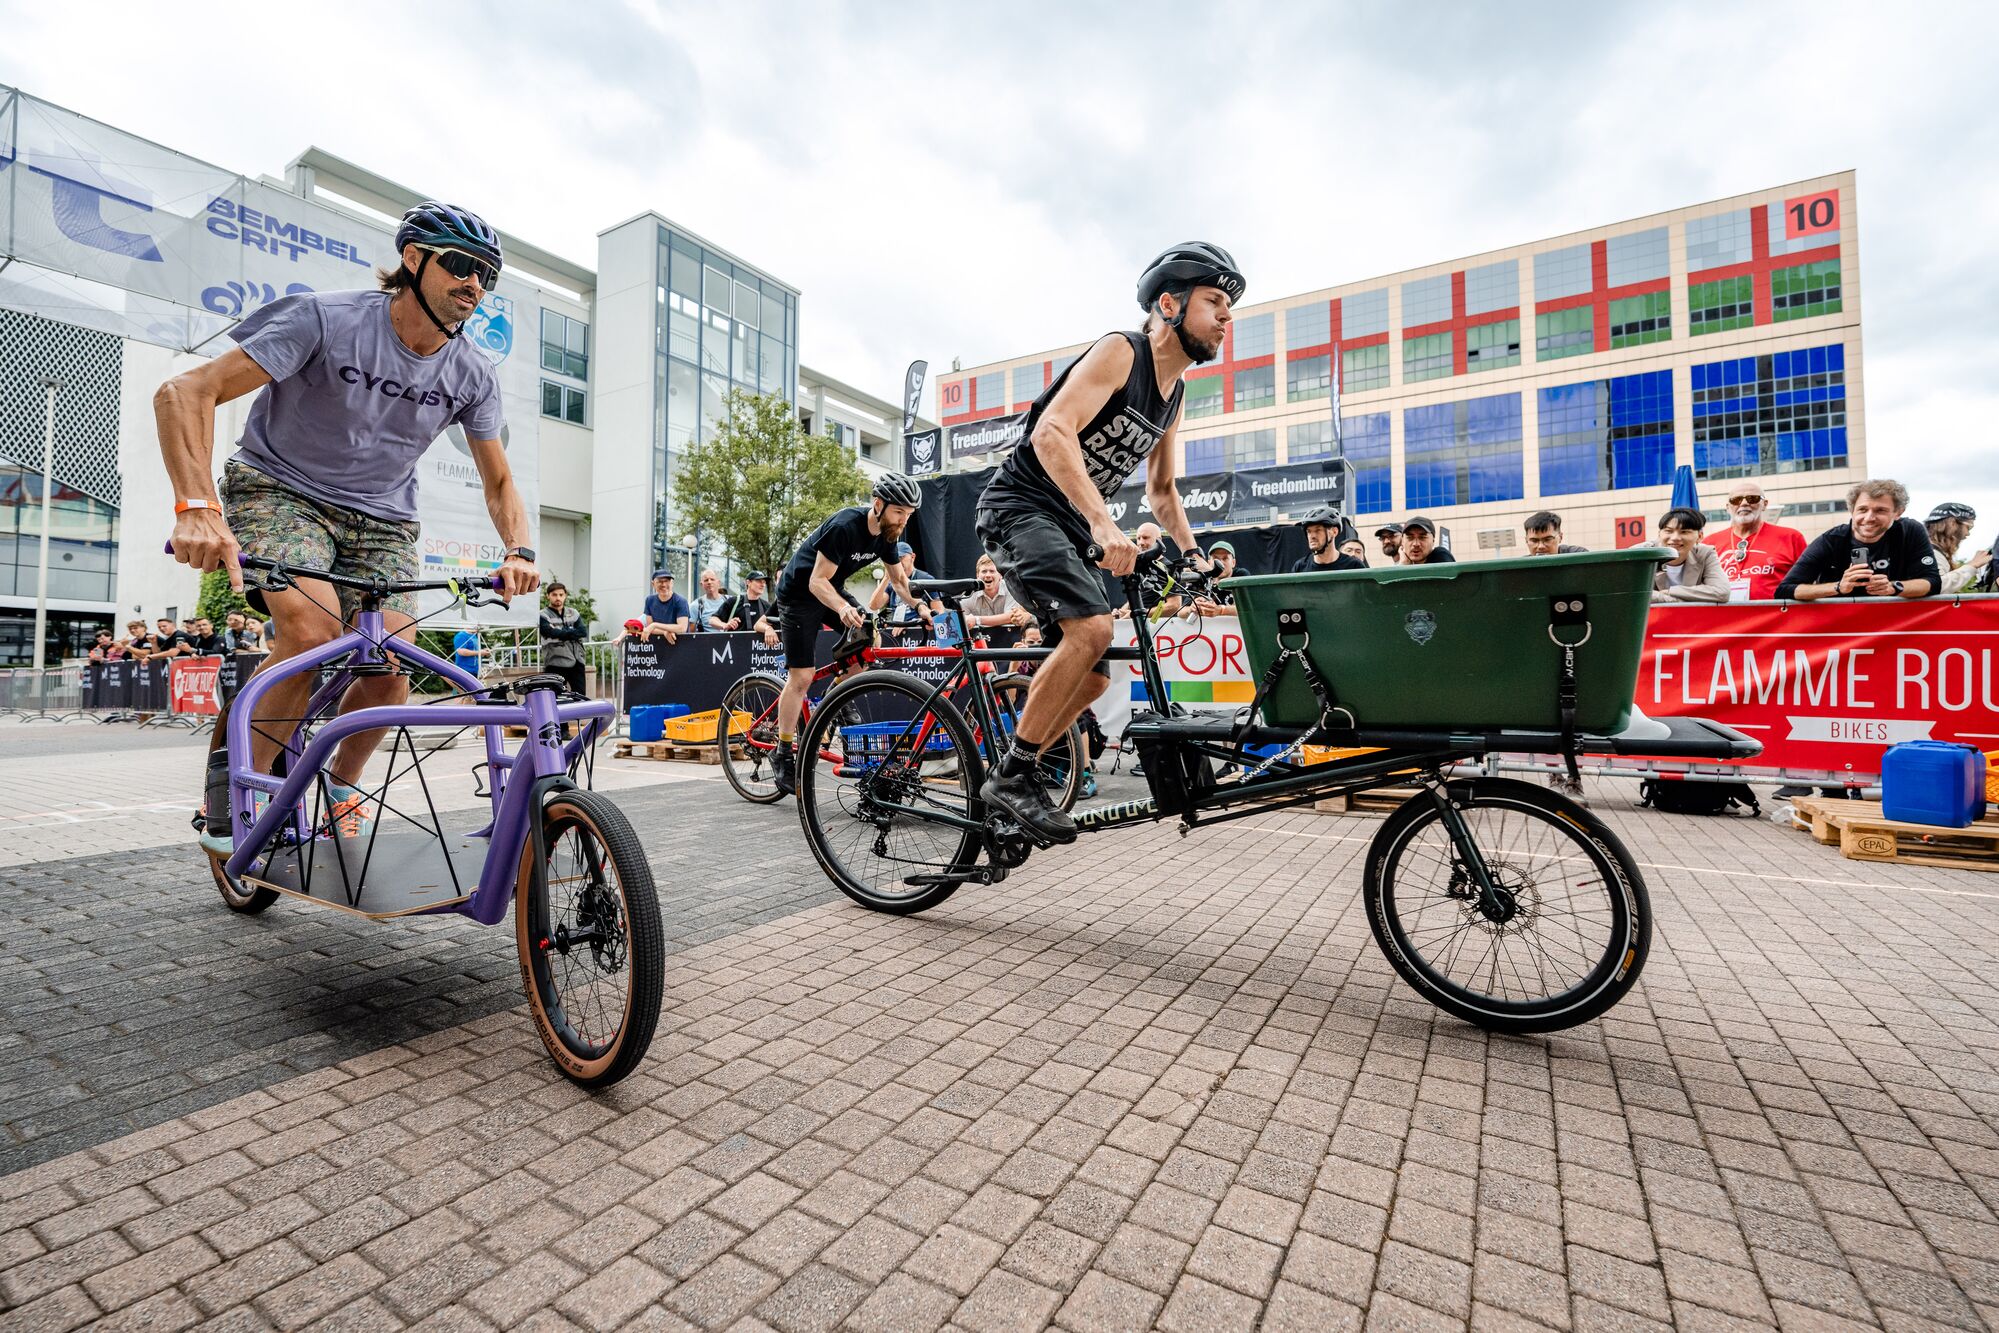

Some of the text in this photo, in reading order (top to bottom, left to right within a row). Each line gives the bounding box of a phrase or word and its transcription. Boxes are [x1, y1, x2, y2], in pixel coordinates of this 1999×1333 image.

[1790, 198, 1834, 231] 10
[206, 196, 372, 268] BEMBEL
[206, 216, 309, 263] CRIT
[338, 365, 459, 410] CYCLIST
[943, 384, 961, 404] 10
[1251, 475, 1337, 497] freedombmx
[1617, 520, 1643, 538] 10
[628, 642, 654, 652] Maurten
[627, 653, 658, 669] Hydrogel
[626, 667, 666, 679] Technology
[1653, 648, 1875, 708] FLAMME
[1830, 721, 1888, 741] BIKES
[1239, 726, 1318, 785] www.carlacargo.de
[1863, 840, 1888, 851] EPAL
[523, 964, 539, 1010] BILLY
